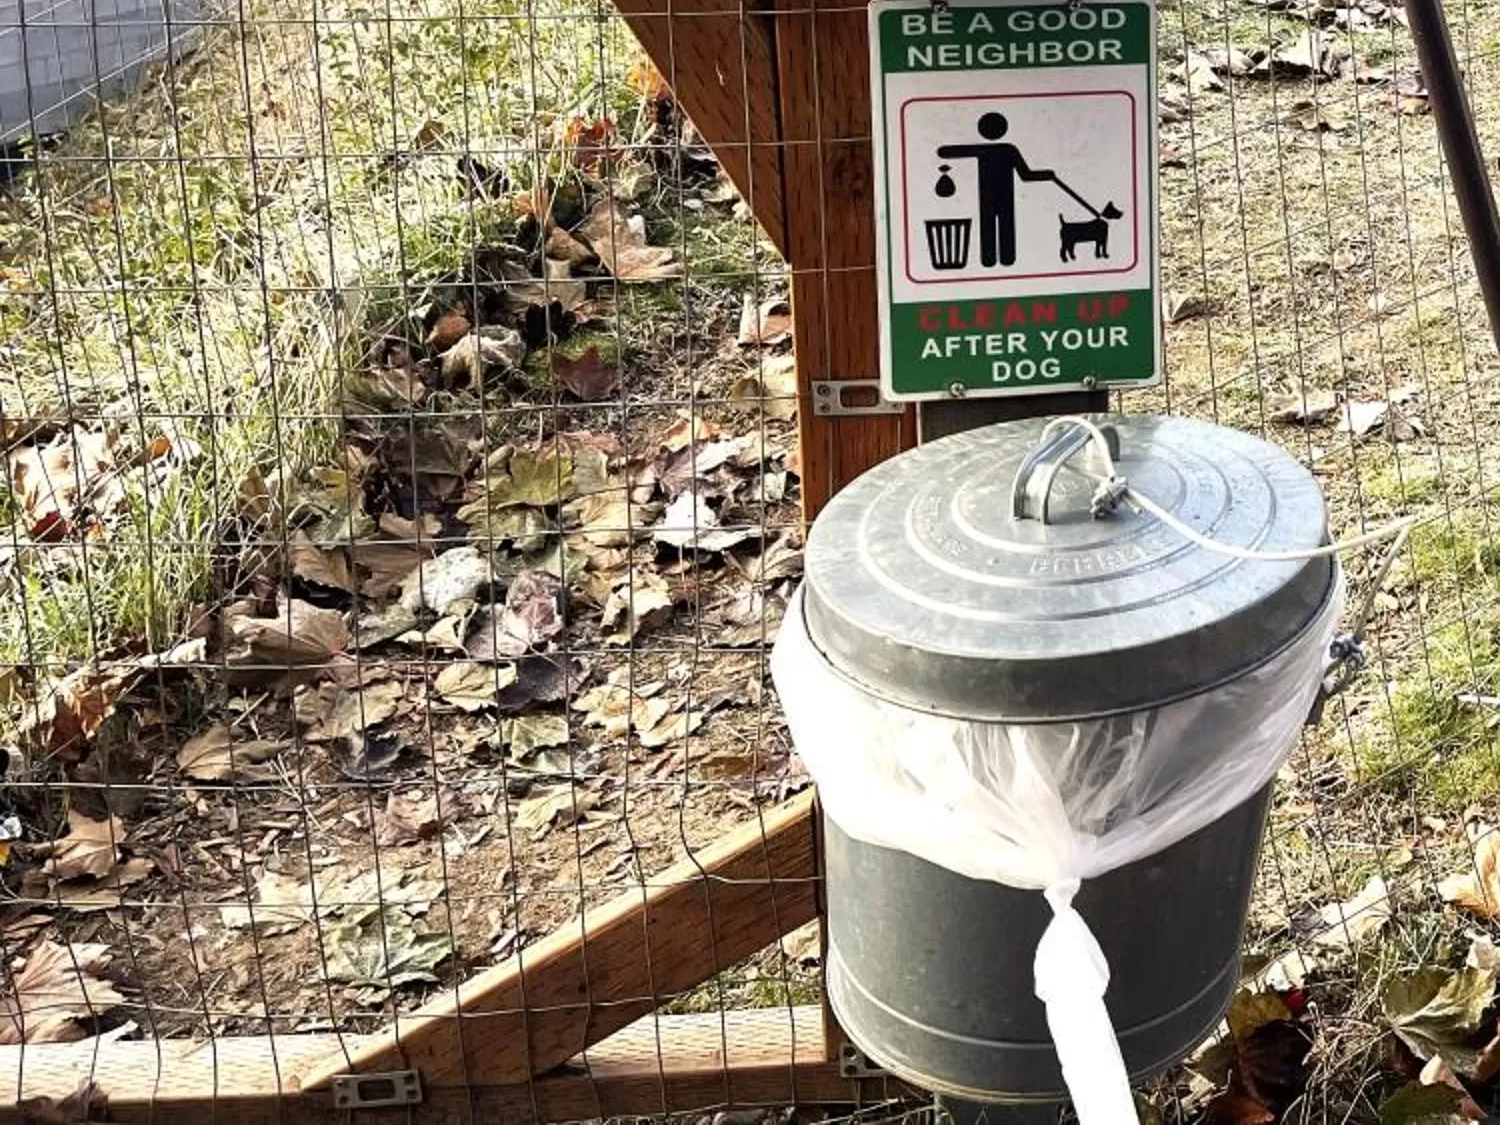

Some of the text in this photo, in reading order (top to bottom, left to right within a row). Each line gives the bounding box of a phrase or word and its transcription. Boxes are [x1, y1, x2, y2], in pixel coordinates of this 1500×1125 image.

[901, 7, 1127, 36] BE A GOOD
[906, 39, 1123, 67] NEIGHBOR
[919, 294, 1131, 333] CLEAN UP
[921, 326, 1129, 360] AFTER YOUR
[991, 358, 1062, 383] DOG
